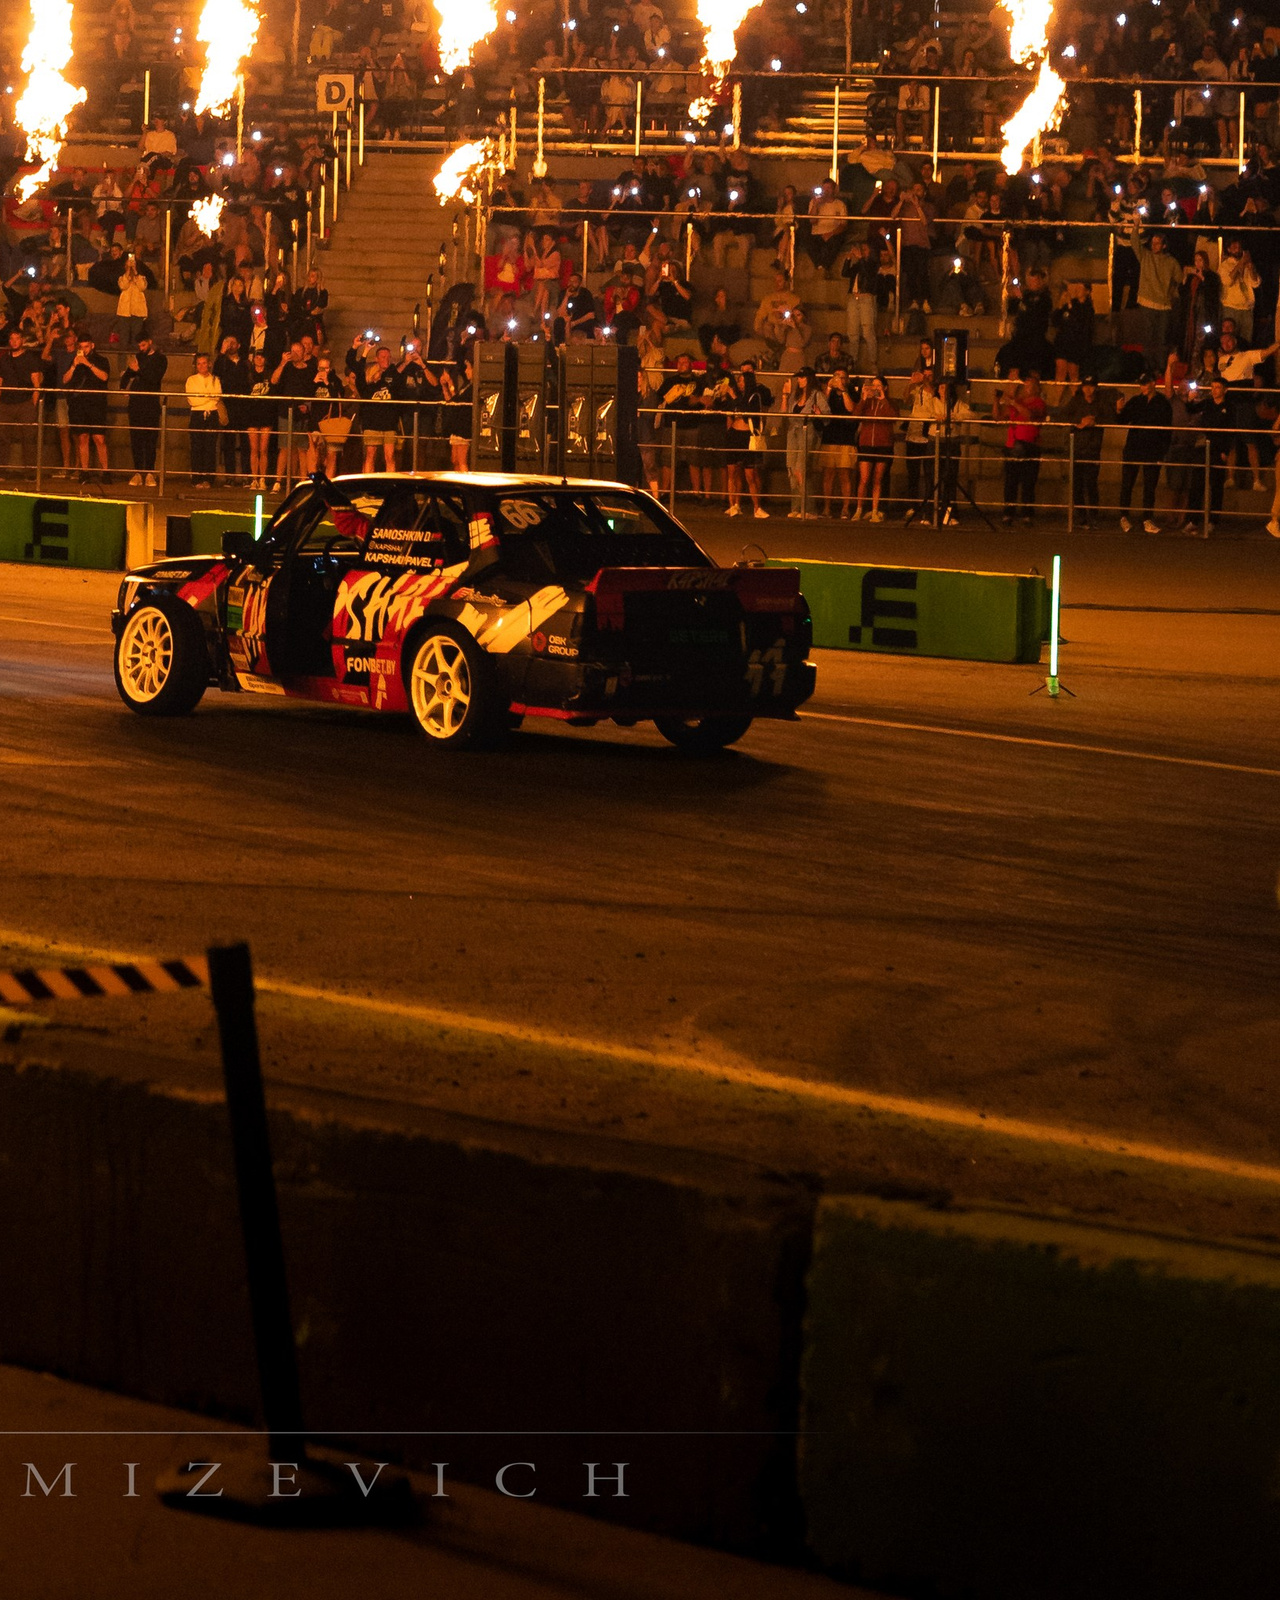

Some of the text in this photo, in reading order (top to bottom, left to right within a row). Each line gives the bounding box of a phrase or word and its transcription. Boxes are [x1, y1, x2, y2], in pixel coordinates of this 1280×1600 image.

[324, 80, 346, 105] D
[499, 498, 542, 530] 66
[371, 527, 423, 542] SAMOSHKIN
[405, 554, 433, 567] PAVEL
[548, 634, 568, 646] OBK
[547, 643, 580, 657] GROUP
[346, 656, 397, 676] FONBET.BY
